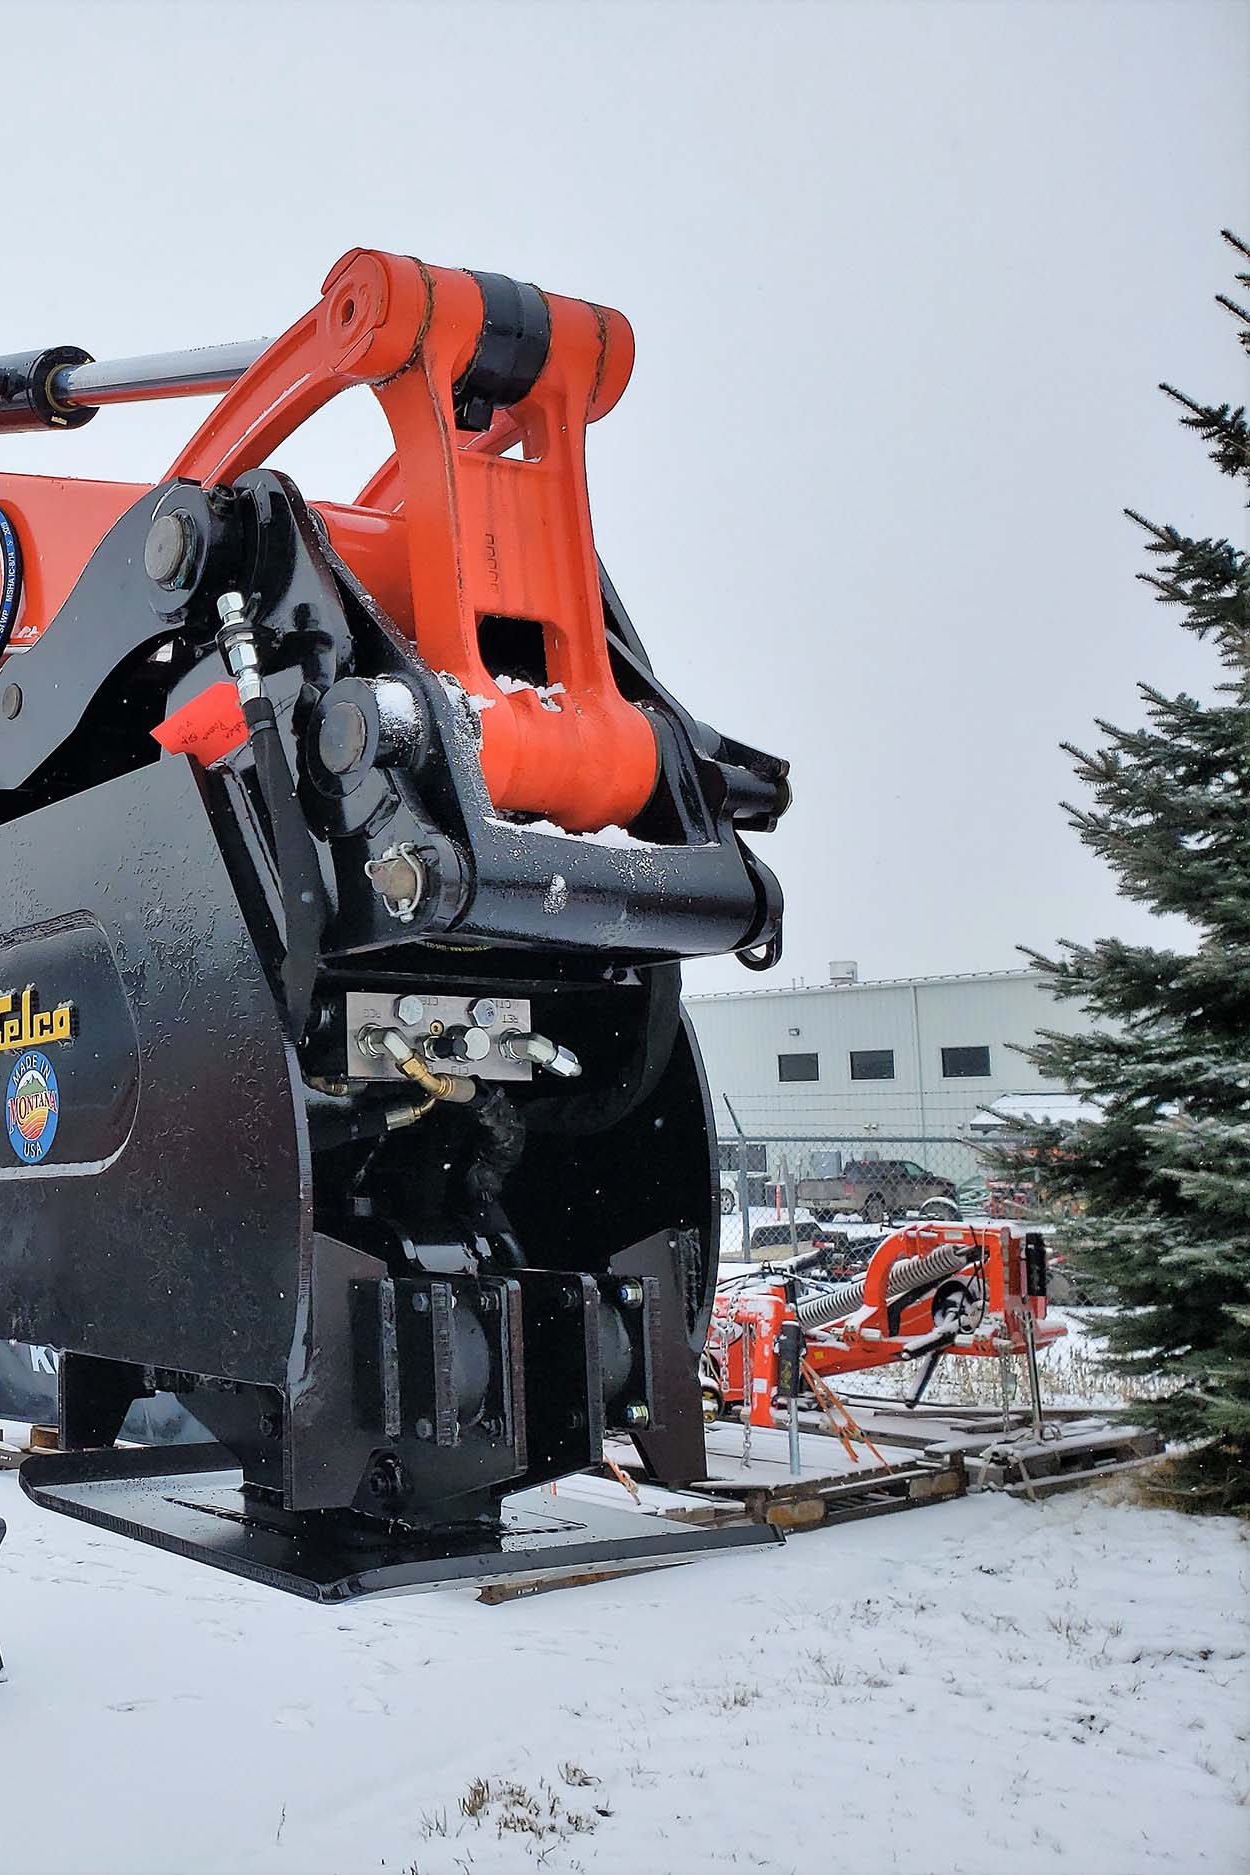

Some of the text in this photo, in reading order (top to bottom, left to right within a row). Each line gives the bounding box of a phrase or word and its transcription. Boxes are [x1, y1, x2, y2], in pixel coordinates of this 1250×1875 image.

[0, 609, 9, 624] WP
[5, 577, 16, 603] MSHA
[13, 1055, 51, 1086] MADE IN
[8, 1089, 58, 1134] MONTANA
[23, 1141, 43, 1158] USA
[30, 1344, 59, 1375] K
